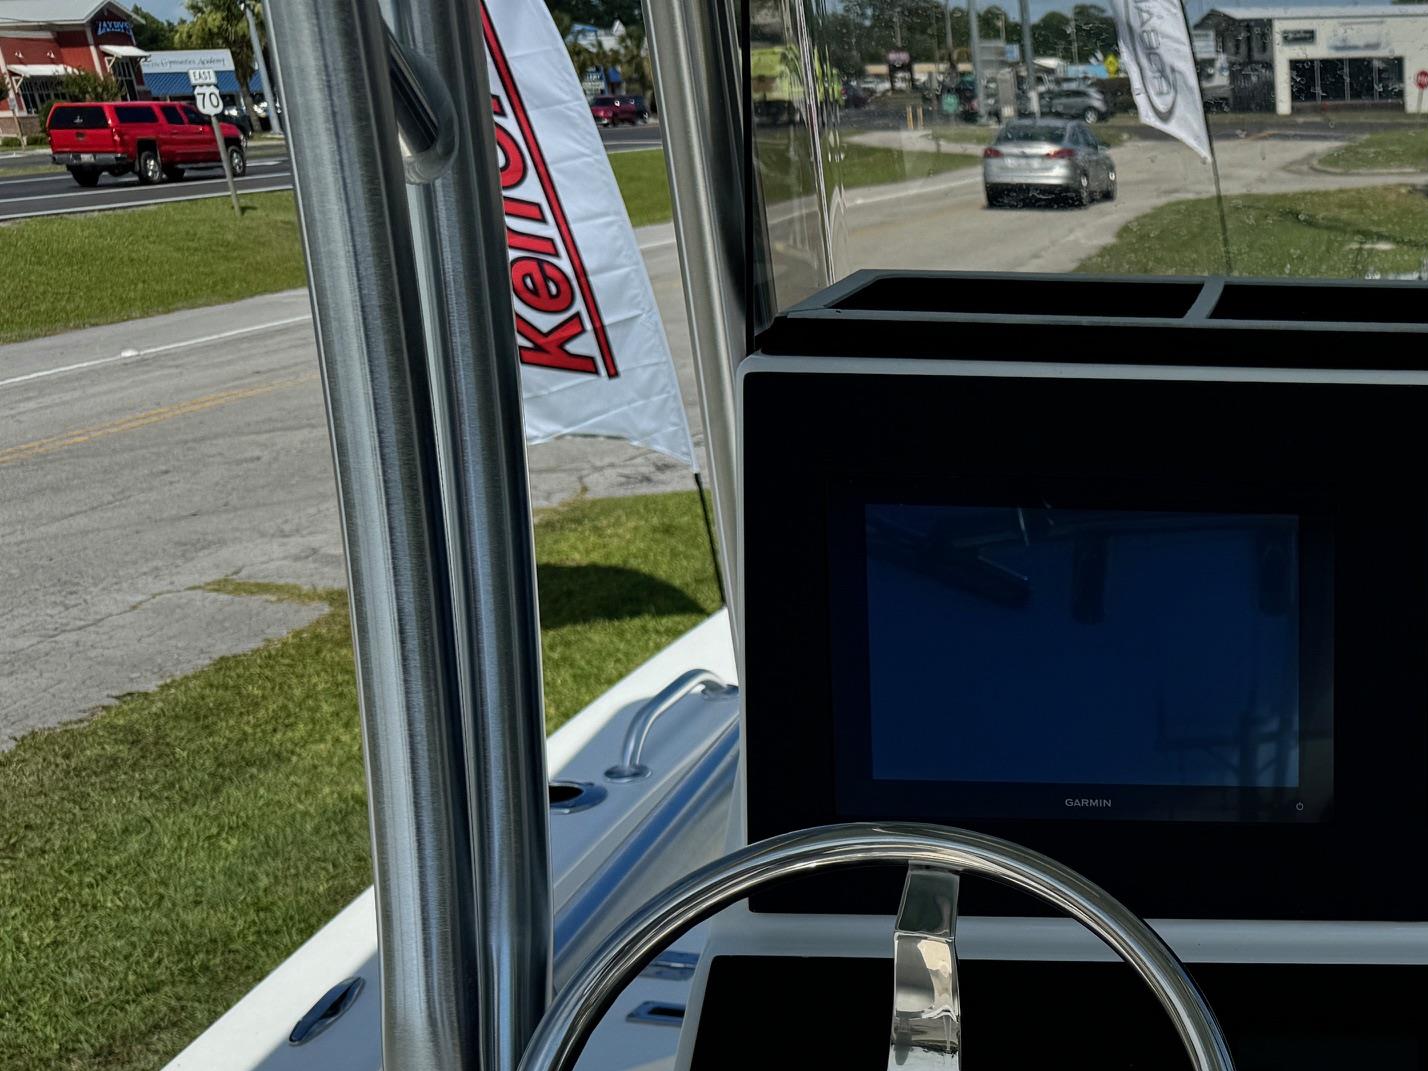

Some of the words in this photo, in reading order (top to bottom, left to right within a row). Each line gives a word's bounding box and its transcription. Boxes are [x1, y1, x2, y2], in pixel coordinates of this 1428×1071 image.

[192, 71, 212, 81] EAST
[196, 92, 220, 110] 70
[1064, 798, 1112, 808] GARMIN
